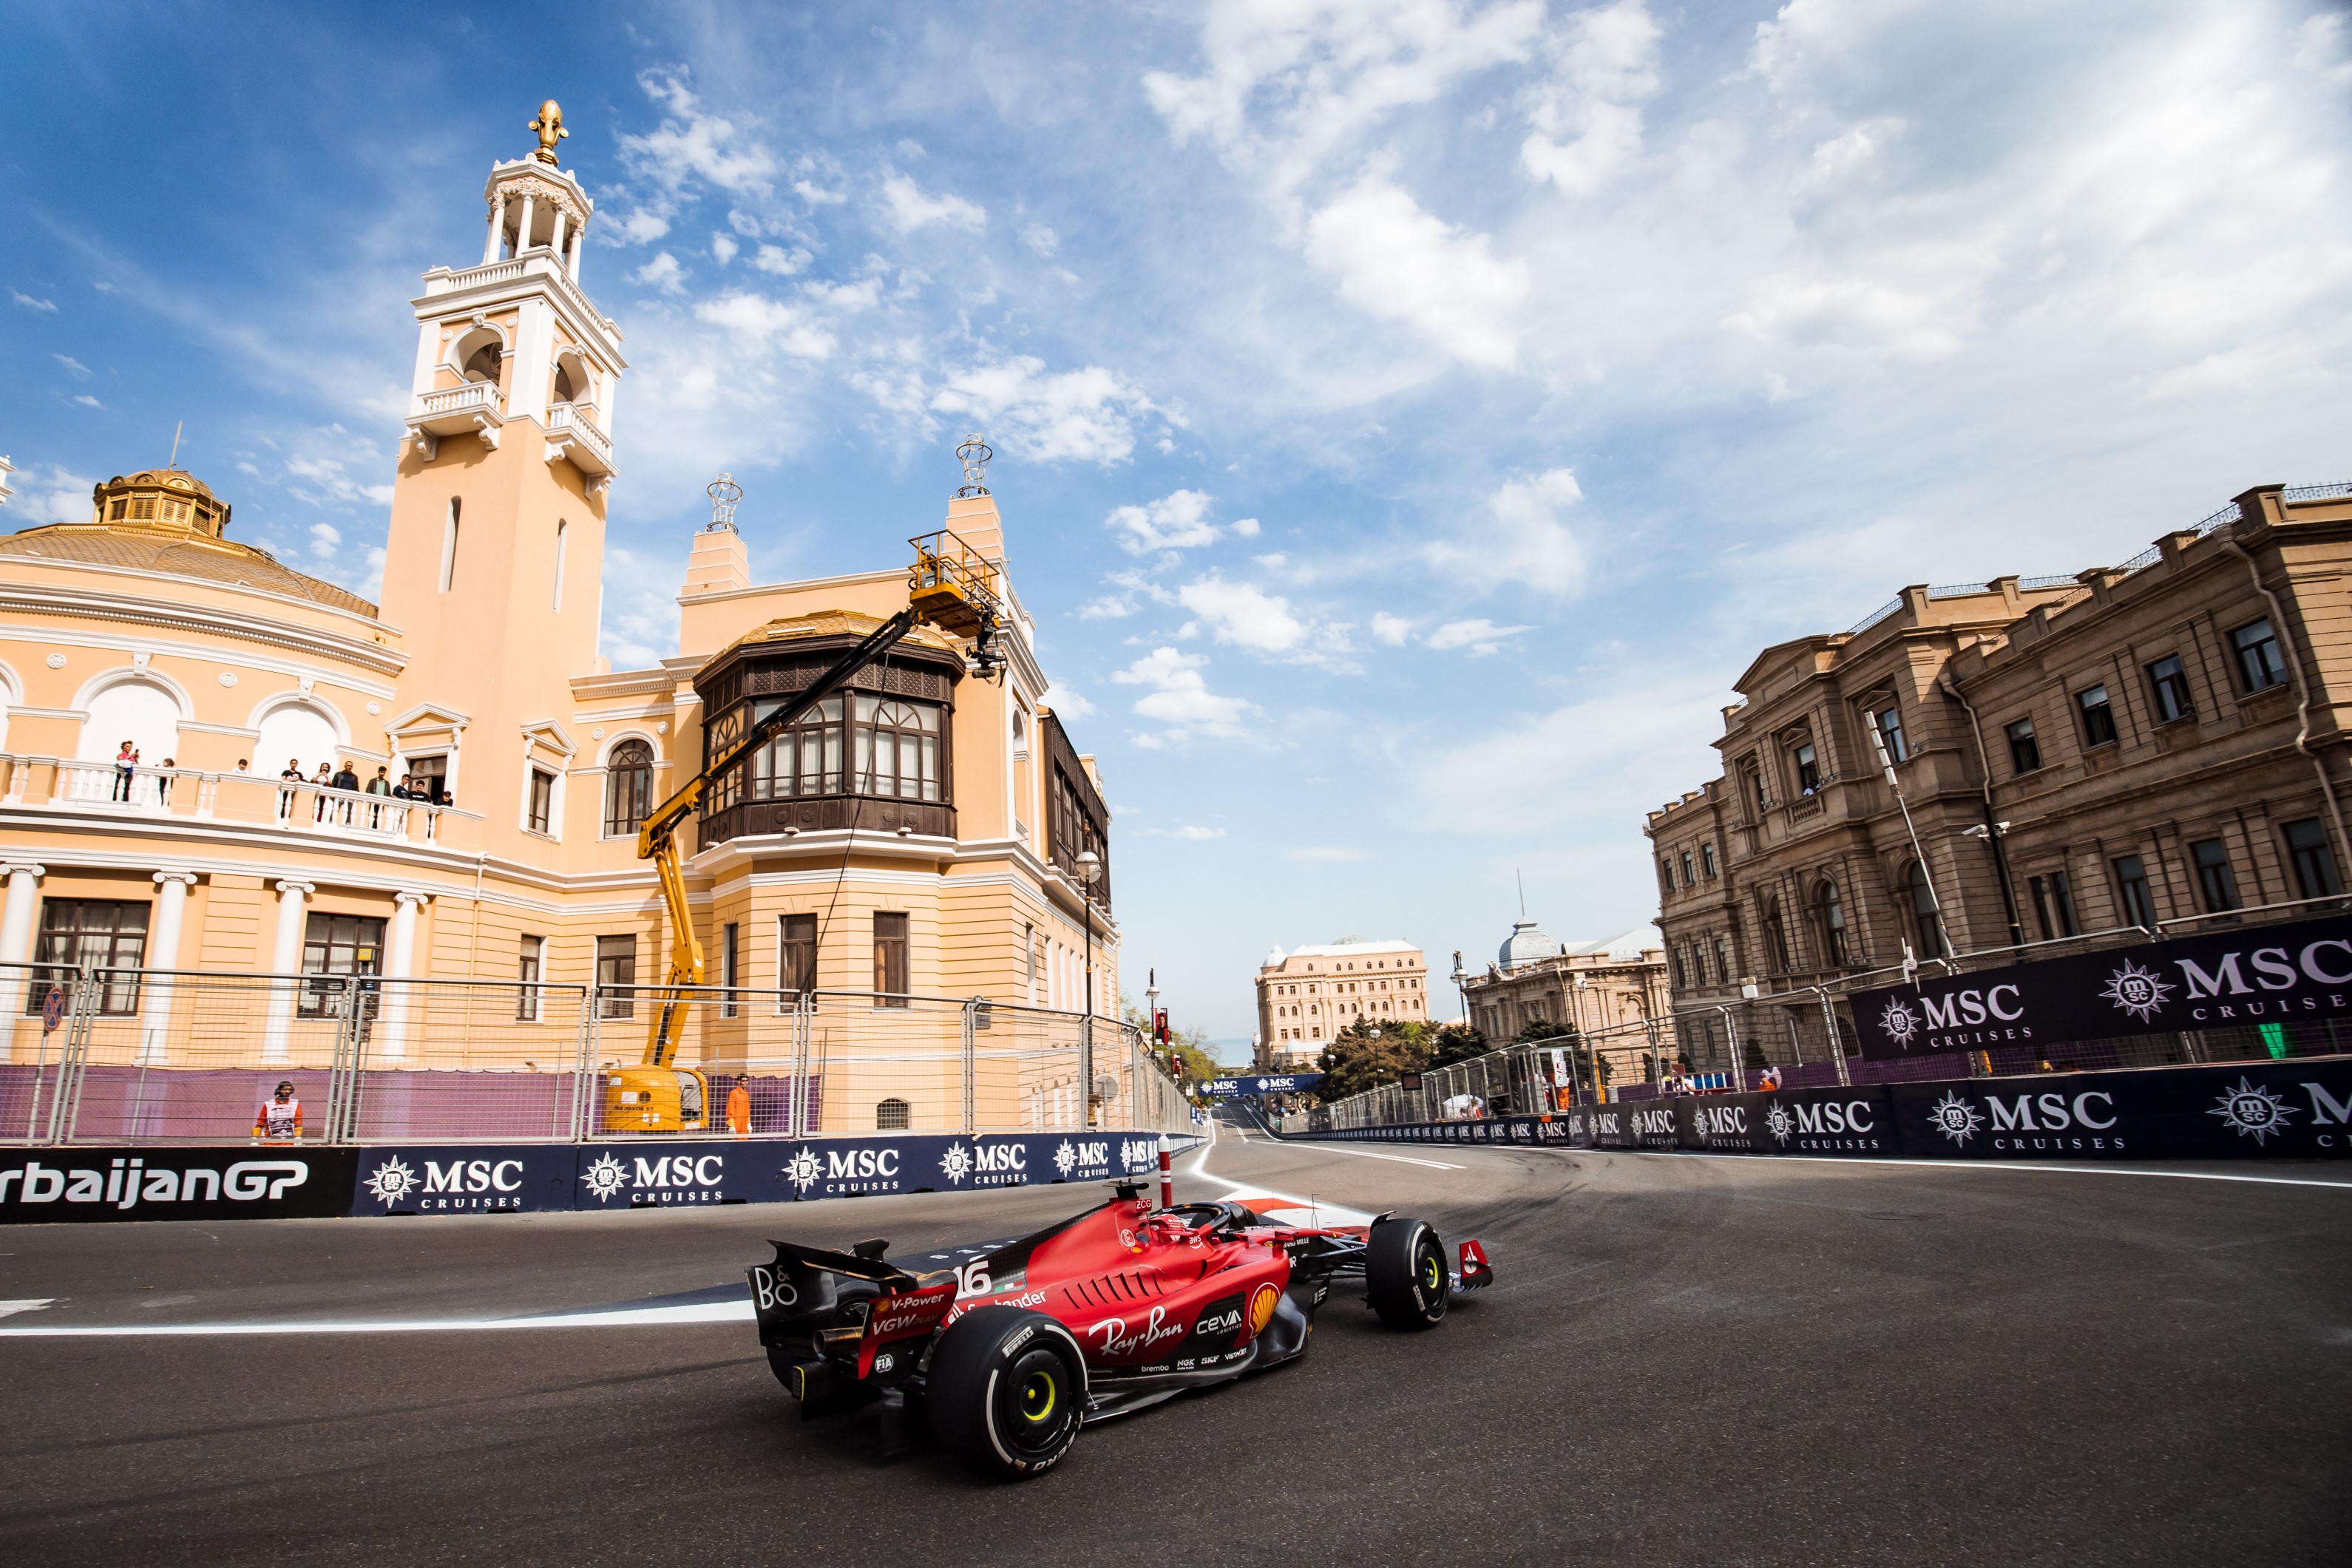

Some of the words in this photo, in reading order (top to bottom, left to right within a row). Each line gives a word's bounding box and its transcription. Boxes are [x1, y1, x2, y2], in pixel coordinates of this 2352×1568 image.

[1919, 984, 2024, 1031] MSC
[1930, 1027, 2032, 1048] CRUISES
[1213, 1081, 1238, 1090] MSC
[1270, 1078, 1294, 1087] MSC
[1793, 1100, 1874, 1134] MSC
[1984, 1091, 2118, 1131] MSC
[1598, 1113, 1620, 1134] MSC
[1642, 1110, 1675, 1133] MSC
[1707, 1106, 1747, 1134] MSC
[1545, 1122, 1566, 1137] MSC
[1712, 1138, 1751, 1147] CRUISES
[1800, 1139, 1879, 1149] CRUISES
[1994, 1138, 2125, 1149] CRUISES
[974, 1144, 1026, 1172] MSC
[1078, 1141, 1108, 1167] MSC
[632, 1155, 723, 1187] MSC
[827, 1149, 899, 1179] MSC
[422, 1160, 523, 1192] MSC
[975, 1173, 1028, 1184] CRUISES
[1078, 1168, 1109, 1178] CRUISES
[827, 1181, 899, 1192] CRUISES
[421, 1197, 521, 1209] CRUISES
[631, 1191, 722, 1203] CRUISES
[1136, 1199, 1151, 1209] ZCG
[1189, 1235, 1202, 1244] aws
[1296, 1237, 1309, 1246] MILLE
[952, 1260, 992, 1300] 16
[892, 1293, 944, 1311] V-Power
[872, 1314, 915, 1336] VGW
[1216, 1323, 1242, 1335] LOGISTICS
[1002, 1326, 1034, 1358] PIRELLI
[876, 1357, 892, 1371] FIA
[1177, 1358, 1196, 1367] NGK
[1201, 1355, 1220, 1365] SKF
[1141, 1364, 1170, 1373] brembo
